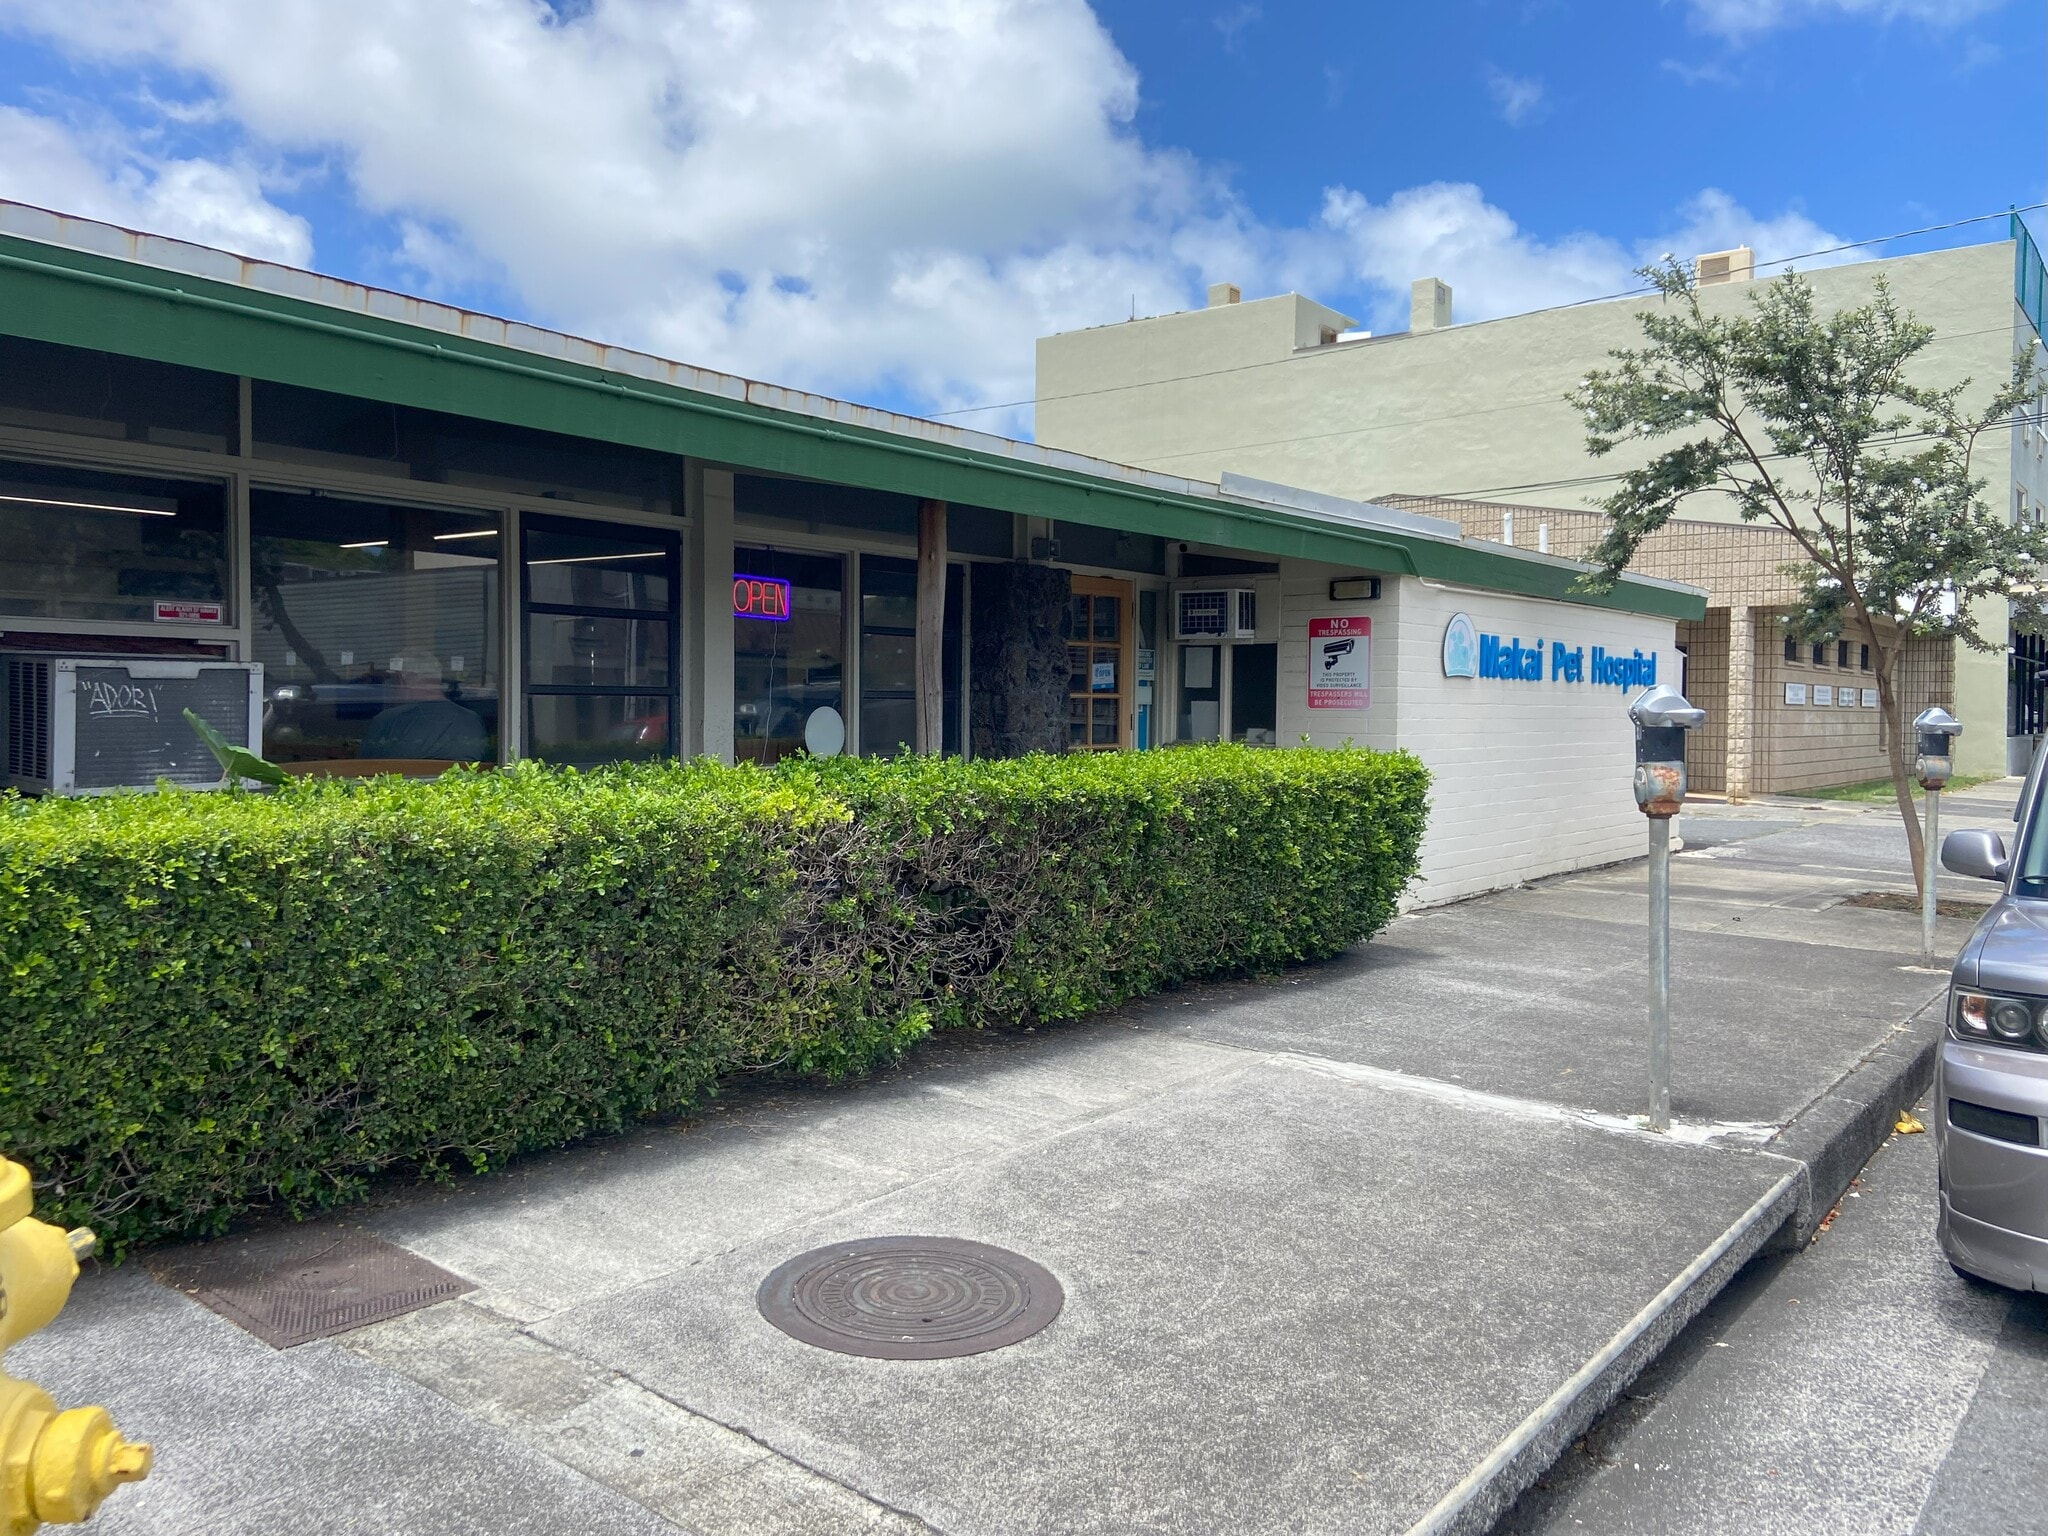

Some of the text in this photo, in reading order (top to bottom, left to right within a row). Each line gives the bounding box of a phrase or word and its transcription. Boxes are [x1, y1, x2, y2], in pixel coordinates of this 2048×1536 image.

[733, 579, 786, 616] OPEN
[1330, 618, 1349, 628] NO
[1318, 628, 1362, 636] TRESPASSING
[1478, 634, 1657, 695] Makai Pet Hospital
[1310, 690, 1353, 698] TRESPASSERS
